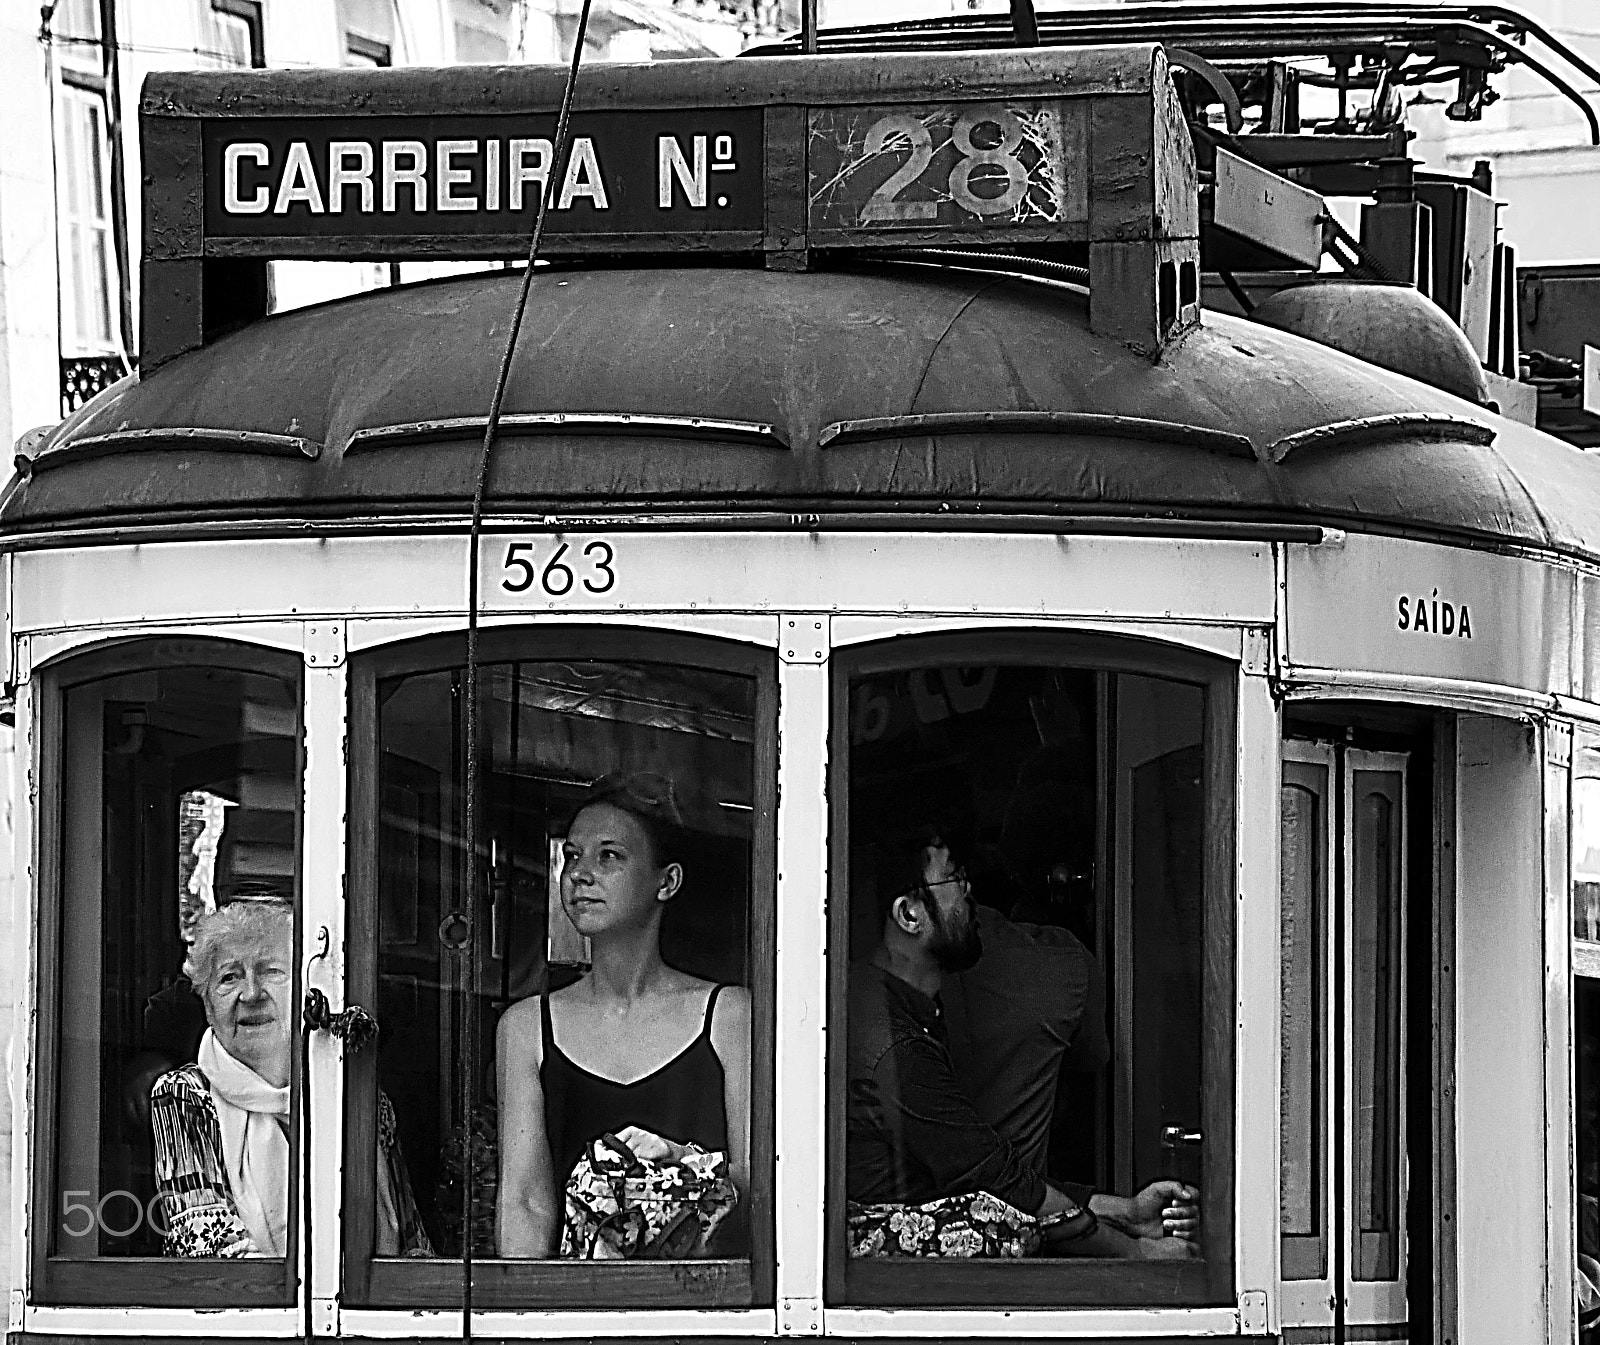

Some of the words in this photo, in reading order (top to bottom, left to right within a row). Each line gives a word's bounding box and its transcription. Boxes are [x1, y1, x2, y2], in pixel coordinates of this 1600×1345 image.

[223, 136, 610, 215] CARREIRA
[858, 104, 1030, 221] 28
[501, 541, 616, 596] 563
[1397, 587, 1473, 639] SAÍDA
